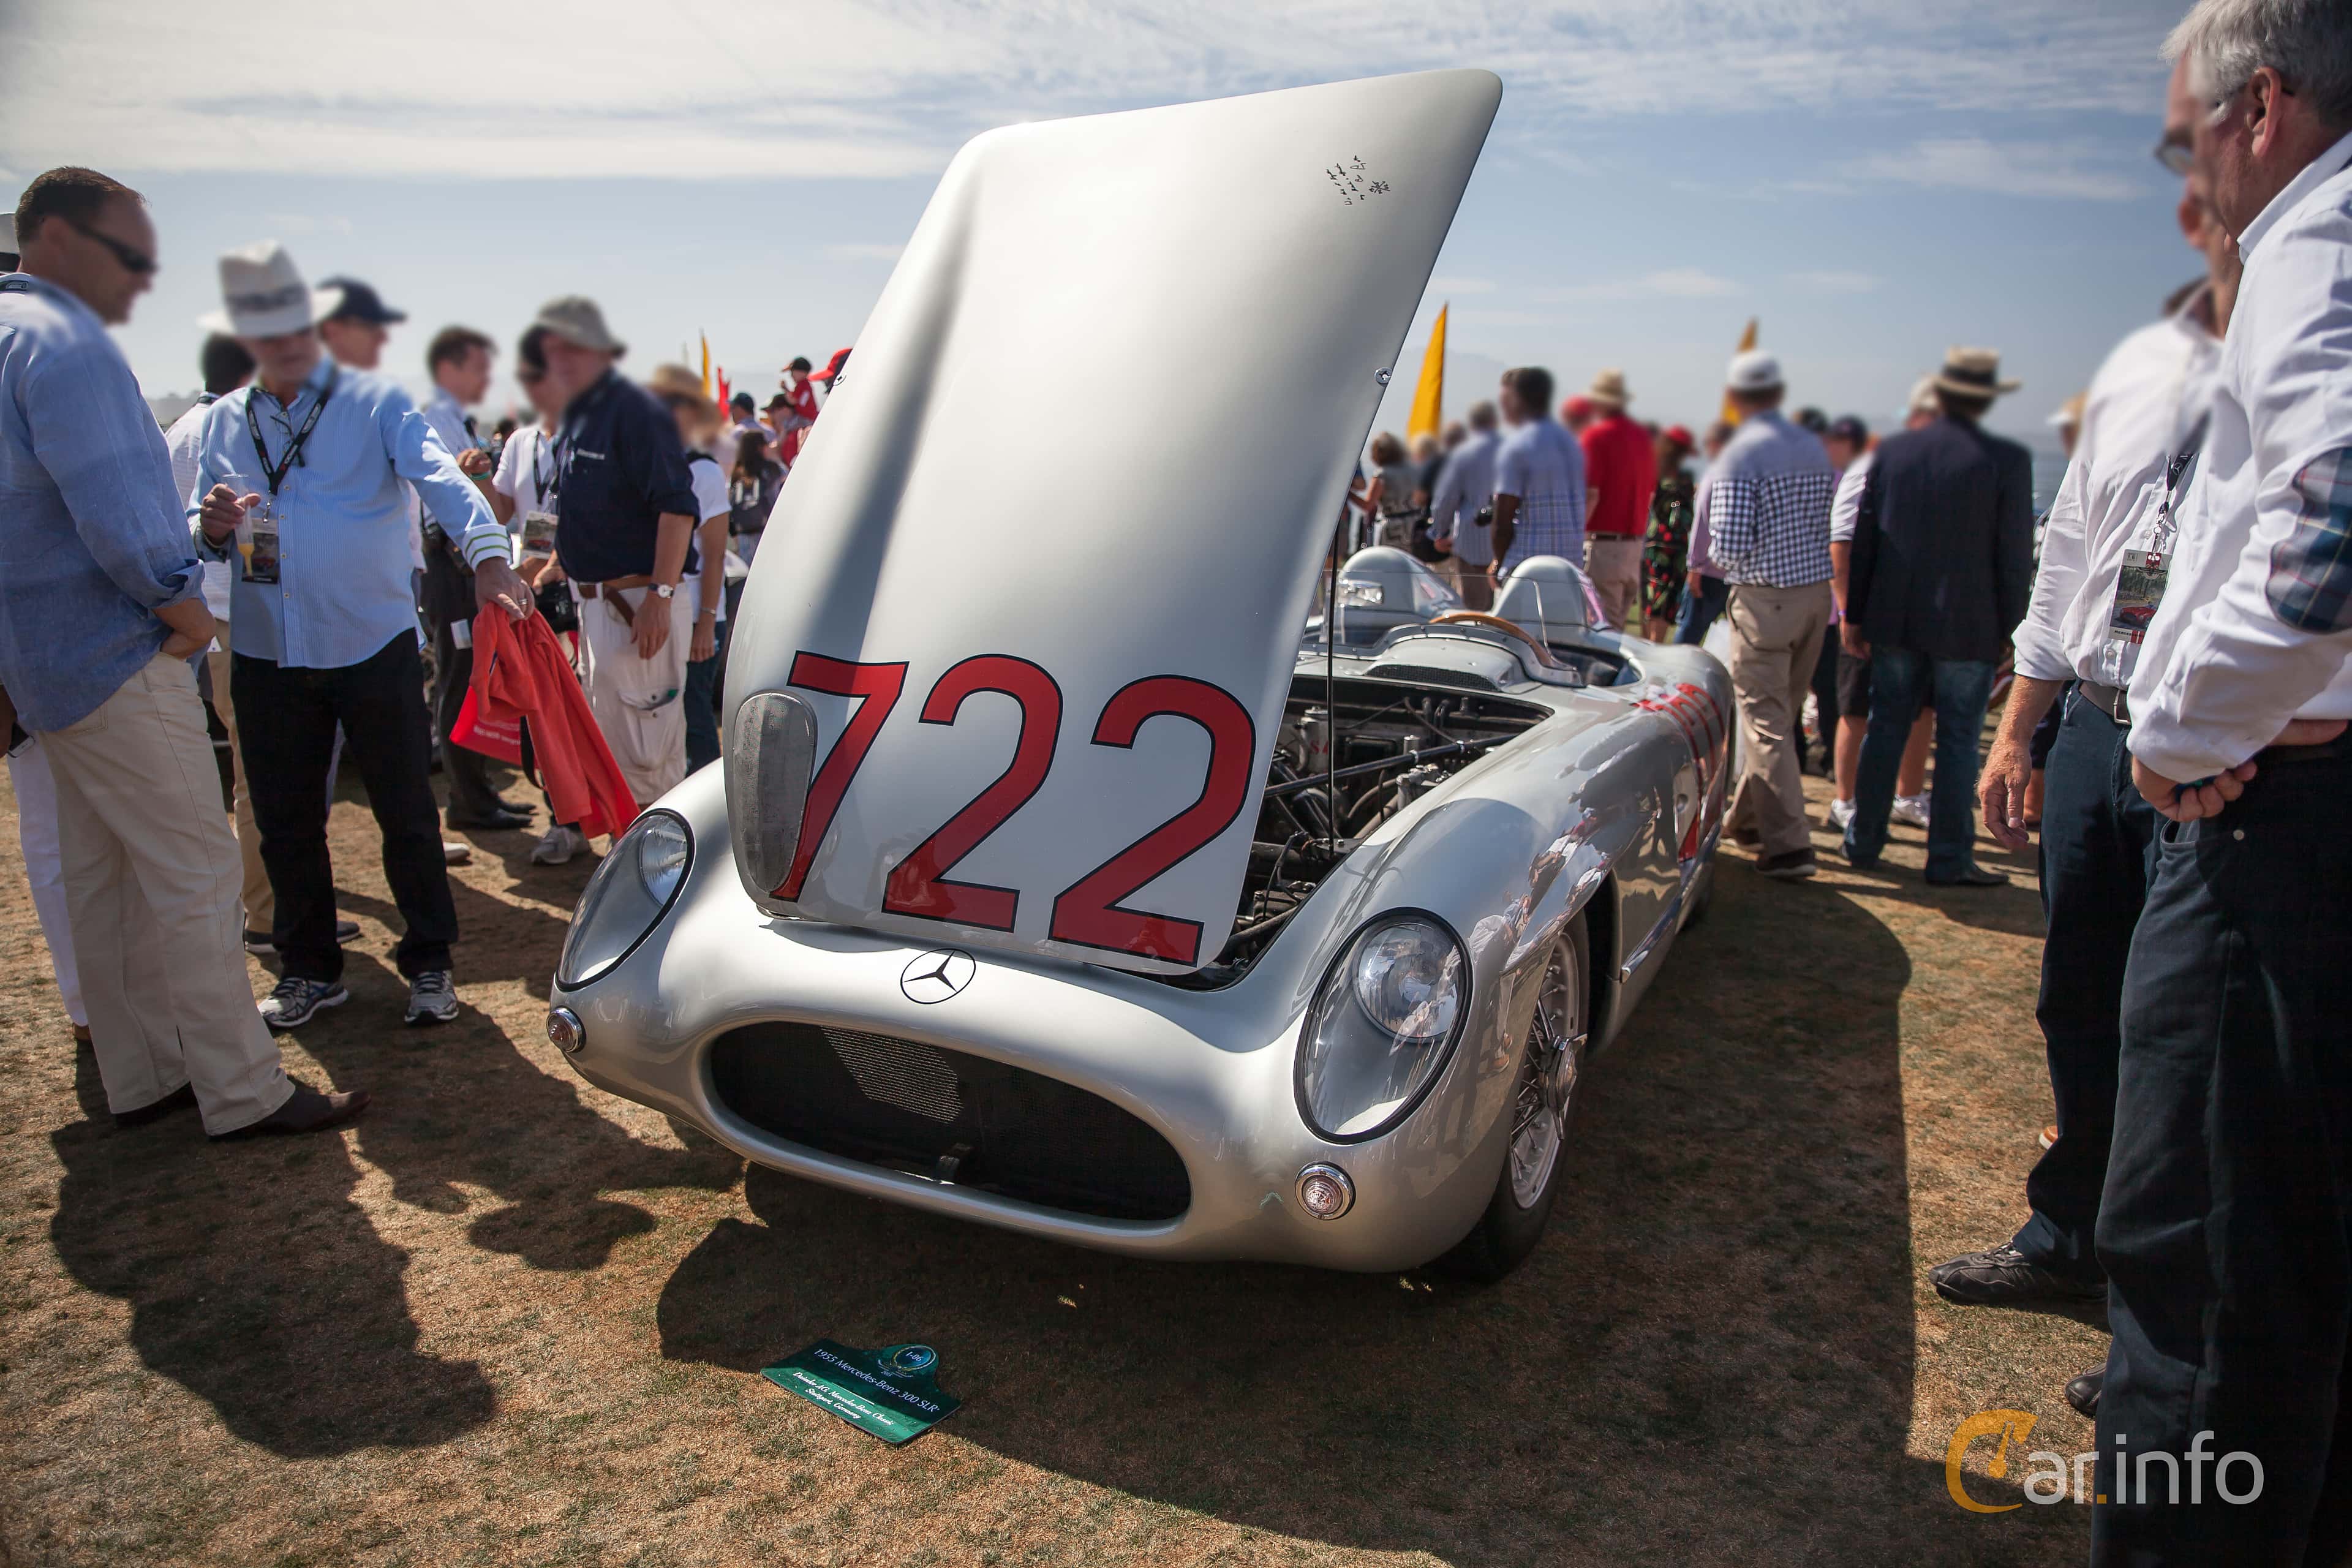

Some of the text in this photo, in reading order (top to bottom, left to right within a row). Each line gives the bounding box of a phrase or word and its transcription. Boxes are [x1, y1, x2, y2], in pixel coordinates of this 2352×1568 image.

[769, 650, 1256, 967] 722
[814, 1349, 838, 1362] 1955
[835, 1359, 900, 1395] Mercedes-Benz
[898, 1391, 919, 1403] 300
[828, 1391, 872, 1415] Mercedes-Benz
[834, 1403, 862, 1419] Germany
